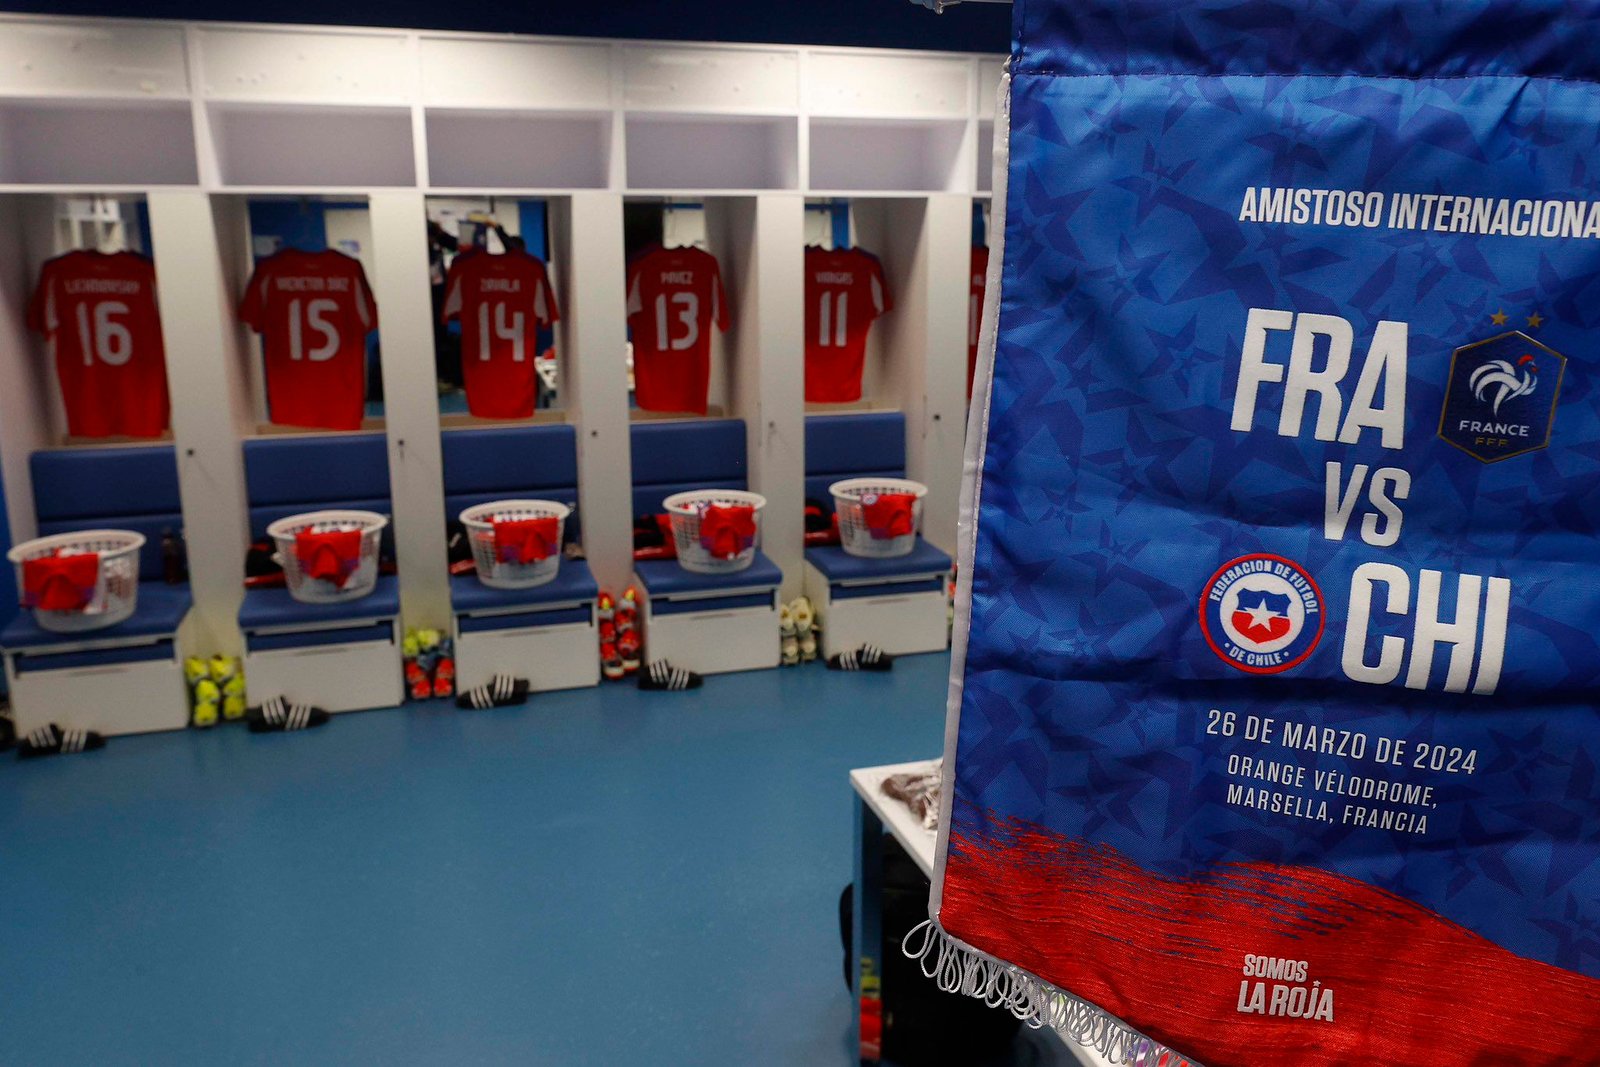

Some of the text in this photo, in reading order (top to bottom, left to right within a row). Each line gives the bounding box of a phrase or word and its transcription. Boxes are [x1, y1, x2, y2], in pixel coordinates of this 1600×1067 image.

[1239, 187, 1383, 228] AMISTOSO
[76, 301, 132, 367] 16
[288, 299, 341, 361] 15
[479, 301, 525, 362] 14
[656, 292, 699, 351] 13
[819, 291, 848, 347] 11
[969, 293, 978, 346] 1
[1230, 307, 1409, 450] FRA
[1459, 420, 1530, 437] FRANCE
[1475, 437, 1508, 447] FFF
[1324, 461, 1412, 547] VS
[1209, 560, 1318, 615] FEDERACION DE FUTBOL
[1229, 646, 1282, 666] DE CHILE
[1341, 561, 1511, 696] CHI
[1206, 709, 1478, 776] 26 DE MARZO DE 2024
[1226, 784, 1428, 835] MARSELLA, FRANCIA
[1227, 754, 1438, 810] ORANGE VÉLODROME,
[1243, 953, 1309, 983] SOMOS
[1237, 980, 1334, 1022] LA ROJA
